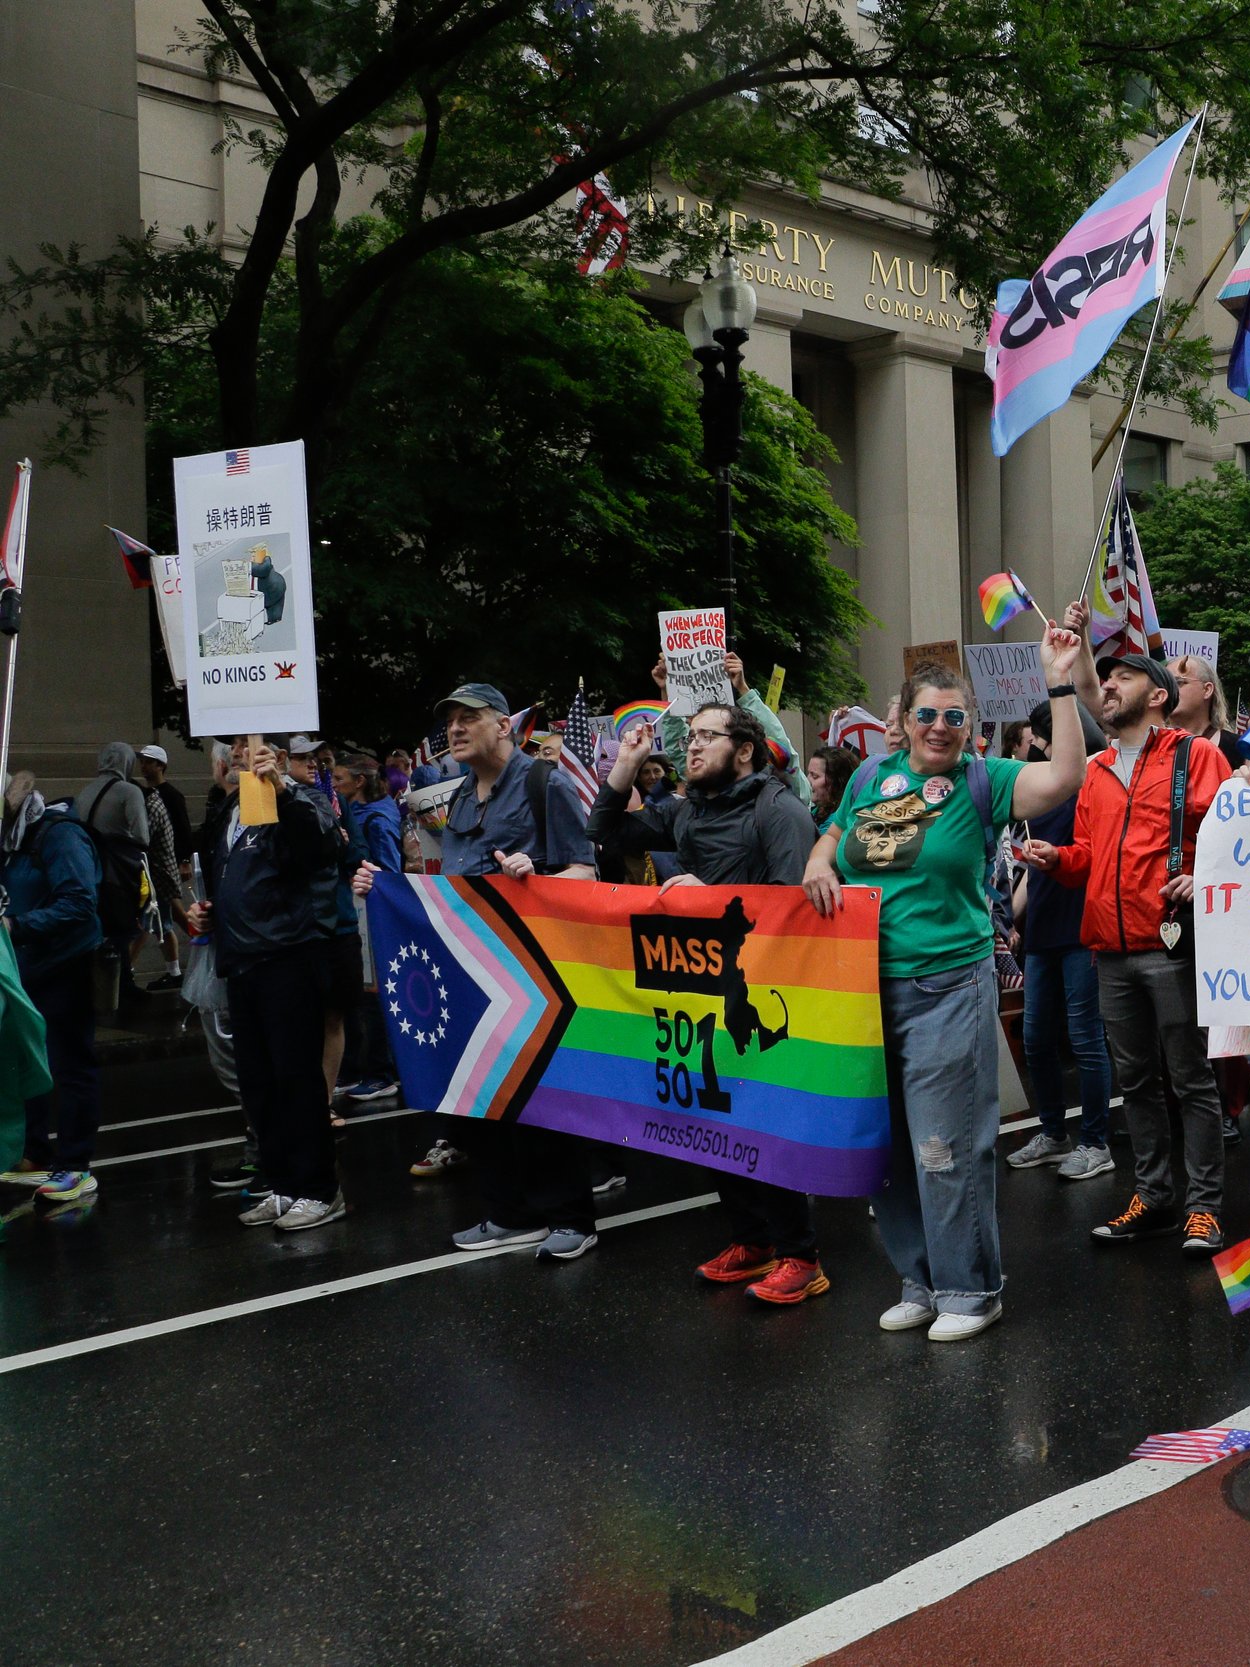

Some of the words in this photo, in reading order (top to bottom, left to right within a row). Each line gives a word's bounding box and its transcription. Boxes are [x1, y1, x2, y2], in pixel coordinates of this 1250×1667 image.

[735, 260, 836, 300] SURANCE
[864, 293, 964, 332] COMPANY
[206, 502, 272, 532] 操特朗普
[665, 616, 690, 632] WHEN
[690, 613, 703, 629] WE
[704, 613, 725, 629] LOSE
[666, 632, 694, 651] OUR
[692, 629, 726, 649] FEAR
[1163, 641, 1178, 657] ALL
[667, 653, 698, 671] THEY
[697, 649, 724, 667] LOSE
[970, 646, 1005, 676] YOU
[1006, 645, 1037, 673] DONT
[202, 668, 221, 685] NO
[225, 665, 266, 683] KINGS
[995, 678, 1026, 695] MADE
[1029, 677, 1042, 694] IN
[981, 699, 1017, 718] WITHOUT
[1174, 769, 1184, 810] MINOLTA
[1201, 882, 1242, 914] IT
[640, 934, 723, 977] MASS
[642, 1117, 760, 1173] mass50501.org
